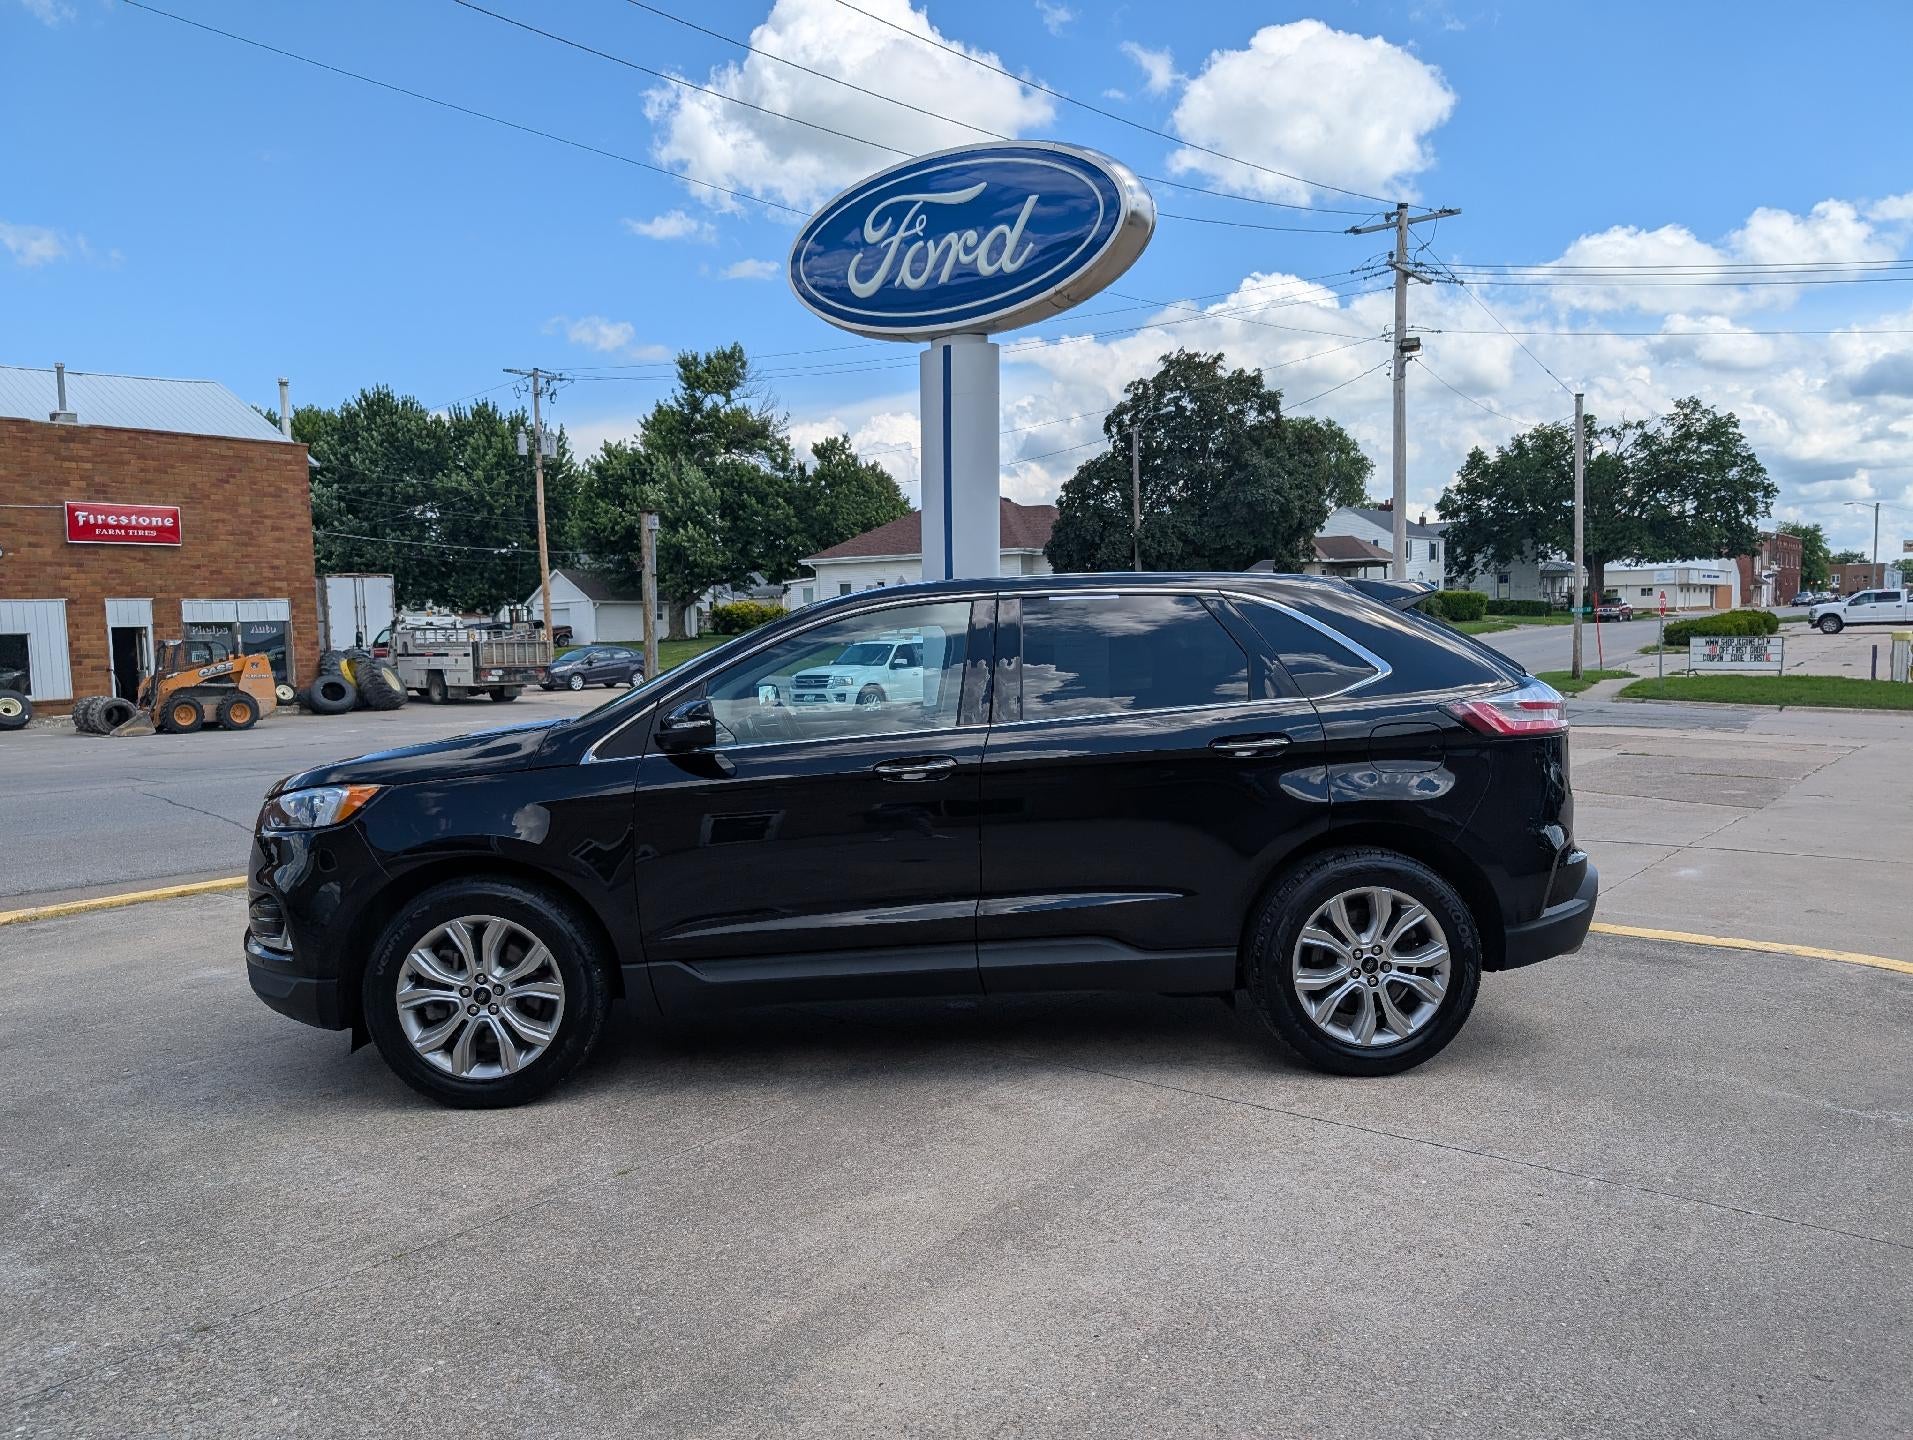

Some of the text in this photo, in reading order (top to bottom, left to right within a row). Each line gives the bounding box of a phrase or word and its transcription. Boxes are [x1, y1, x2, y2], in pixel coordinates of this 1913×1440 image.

[847, 181, 1040, 299] Ford
[74, 511, 174, 527] Firestone
[95, 528, 125, 536] FARM
[1719, 646, 1730, 654] OFF
[1731, 646, 1748, 654] FIRST
[1749, 646, 1768, 654] ORDER
[198, 662, 234, 677] CASE
